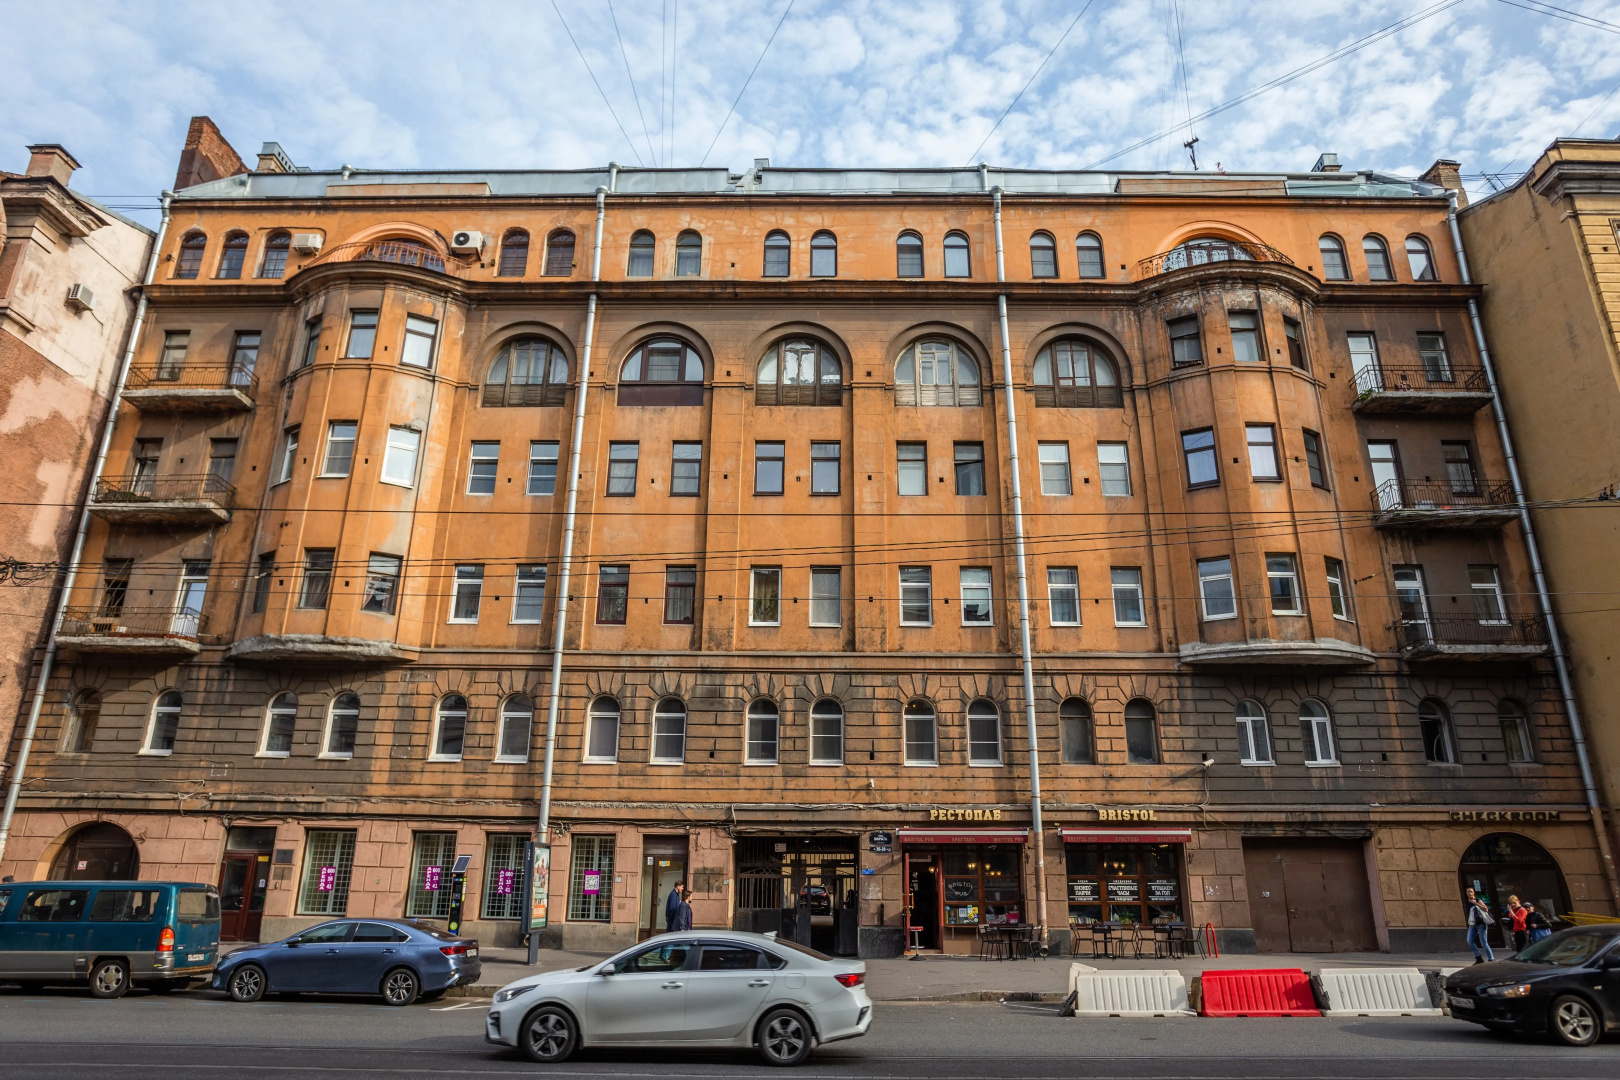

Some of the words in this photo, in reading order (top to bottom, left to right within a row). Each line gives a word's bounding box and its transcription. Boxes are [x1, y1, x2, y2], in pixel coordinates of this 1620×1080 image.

[930, 809, 1002, 821] РЕСТОПАБ
[1098, 809, 1158, 821] BRISTOL
[1450, 810, 1560, 821] CHECKROOM
